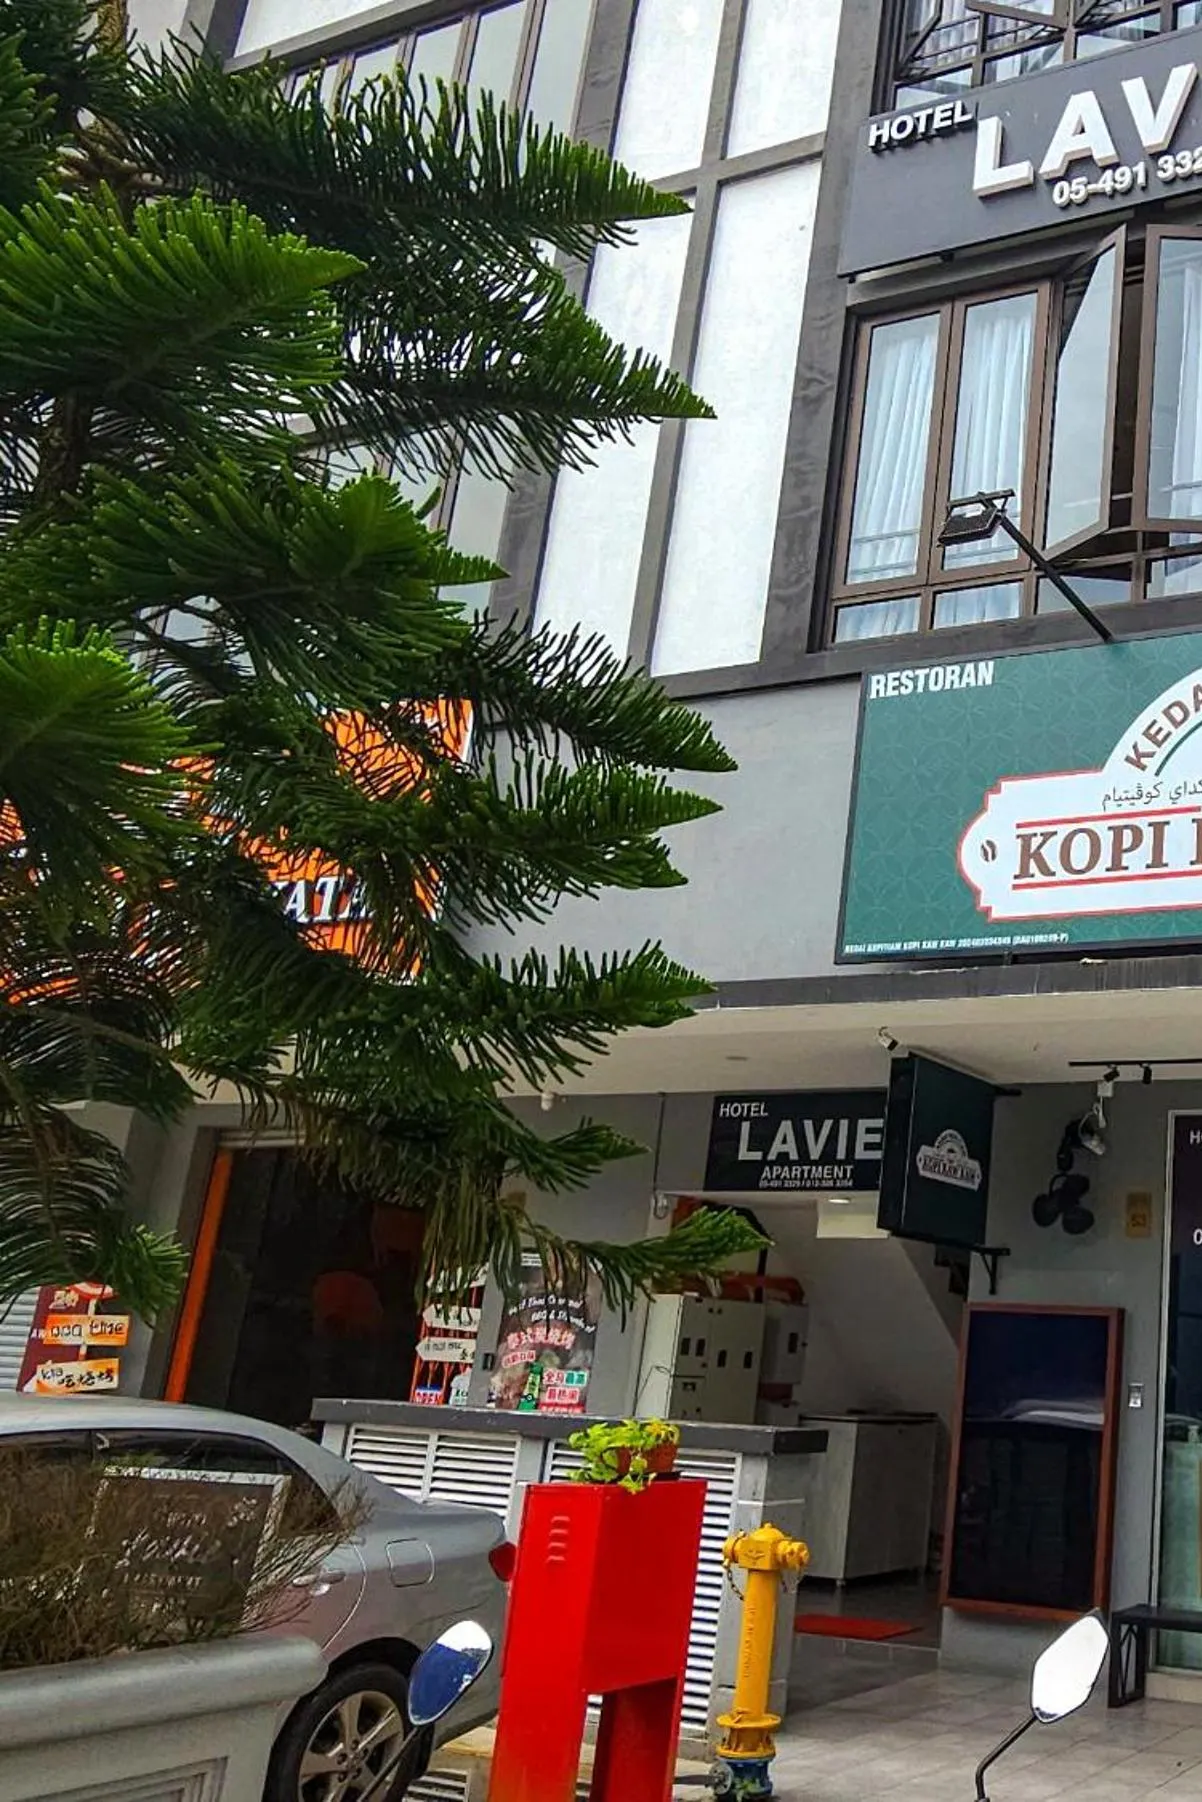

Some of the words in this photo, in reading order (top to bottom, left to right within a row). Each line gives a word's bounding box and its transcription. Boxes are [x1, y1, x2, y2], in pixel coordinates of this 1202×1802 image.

[868, 100, 974, 148] HOTEL
[1053, 162, 1147, 207] 05-491
[870, 661, 995, 699] RESTORAN
[1013, 821, 1171, 880] KOPI
[719, 1102, 769, 1118] HOTEL
[738, 1118, 884, 1160] LAVIE
[760, 1165, 854, 1179] APARTMENT
